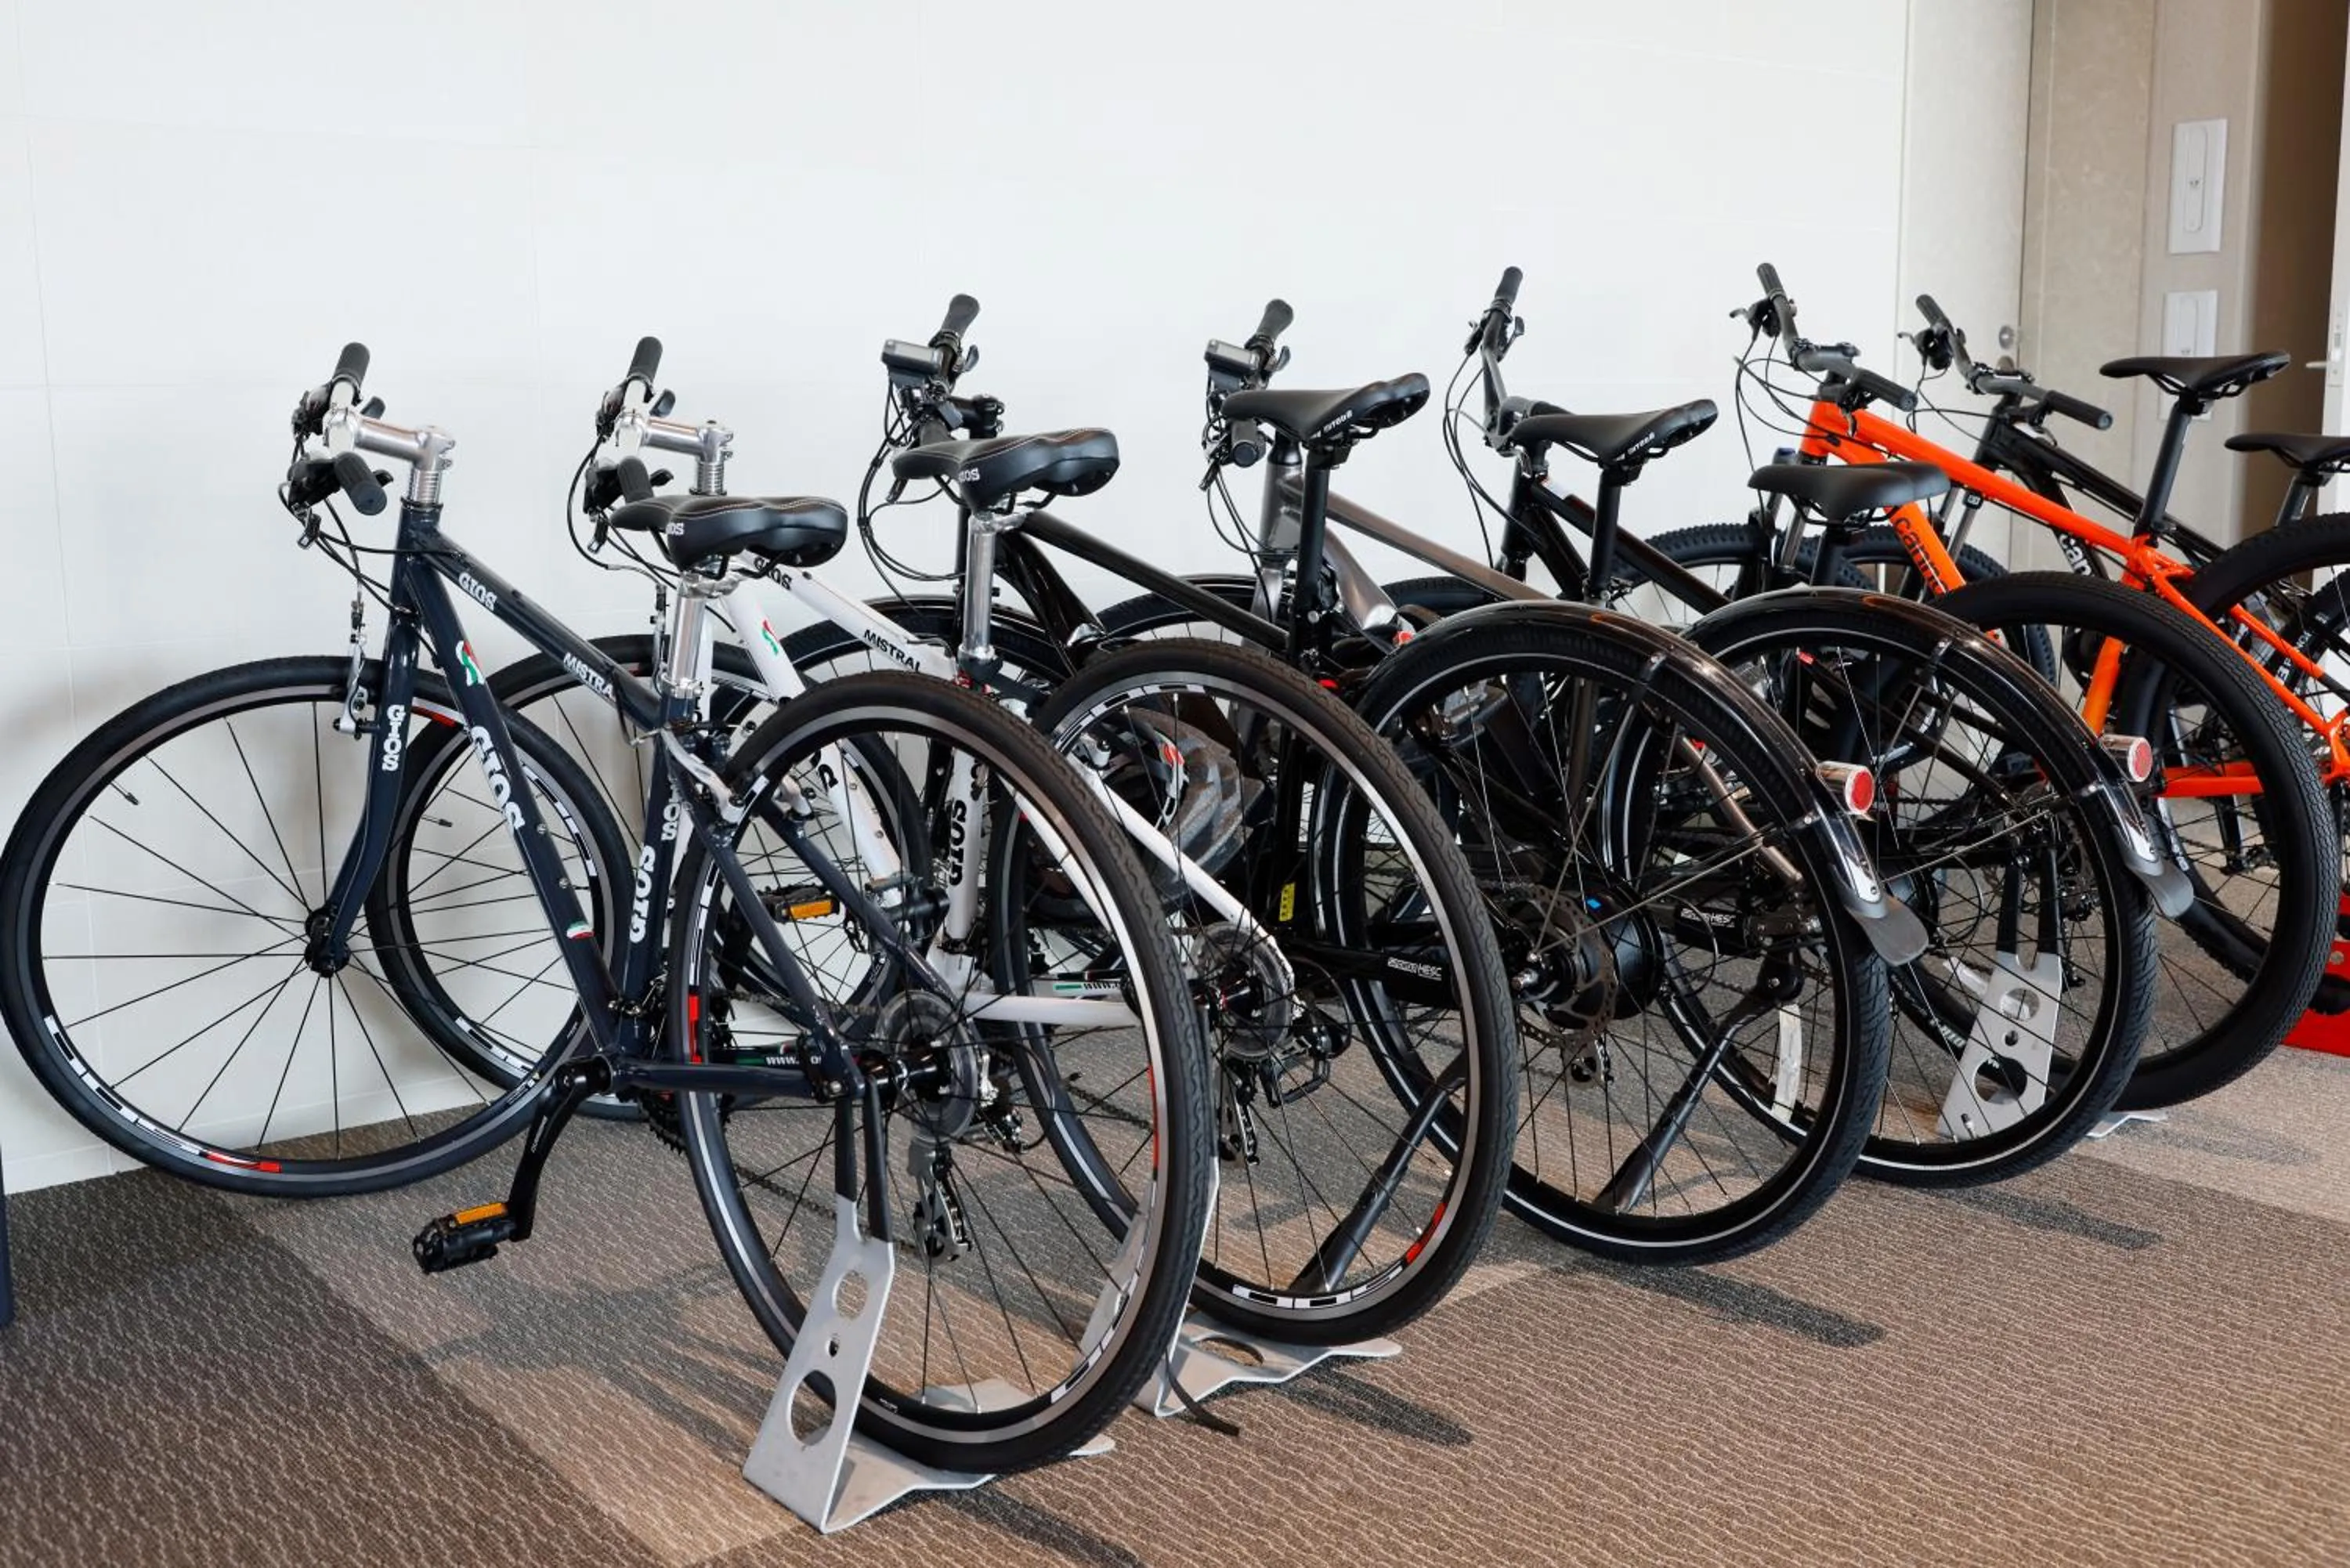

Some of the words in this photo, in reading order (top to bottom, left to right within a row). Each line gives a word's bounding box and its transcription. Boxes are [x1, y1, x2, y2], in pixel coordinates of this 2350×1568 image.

[458, 572, 497, 611] GIOS
[754, 556, 792, 591] GOS
[381, 704, 406, 771] GIOS
[469, 725, 526, 831] GIOS
[949, 800, 967, 887] GIOS
[629, 845, 656, 944] GIOS
